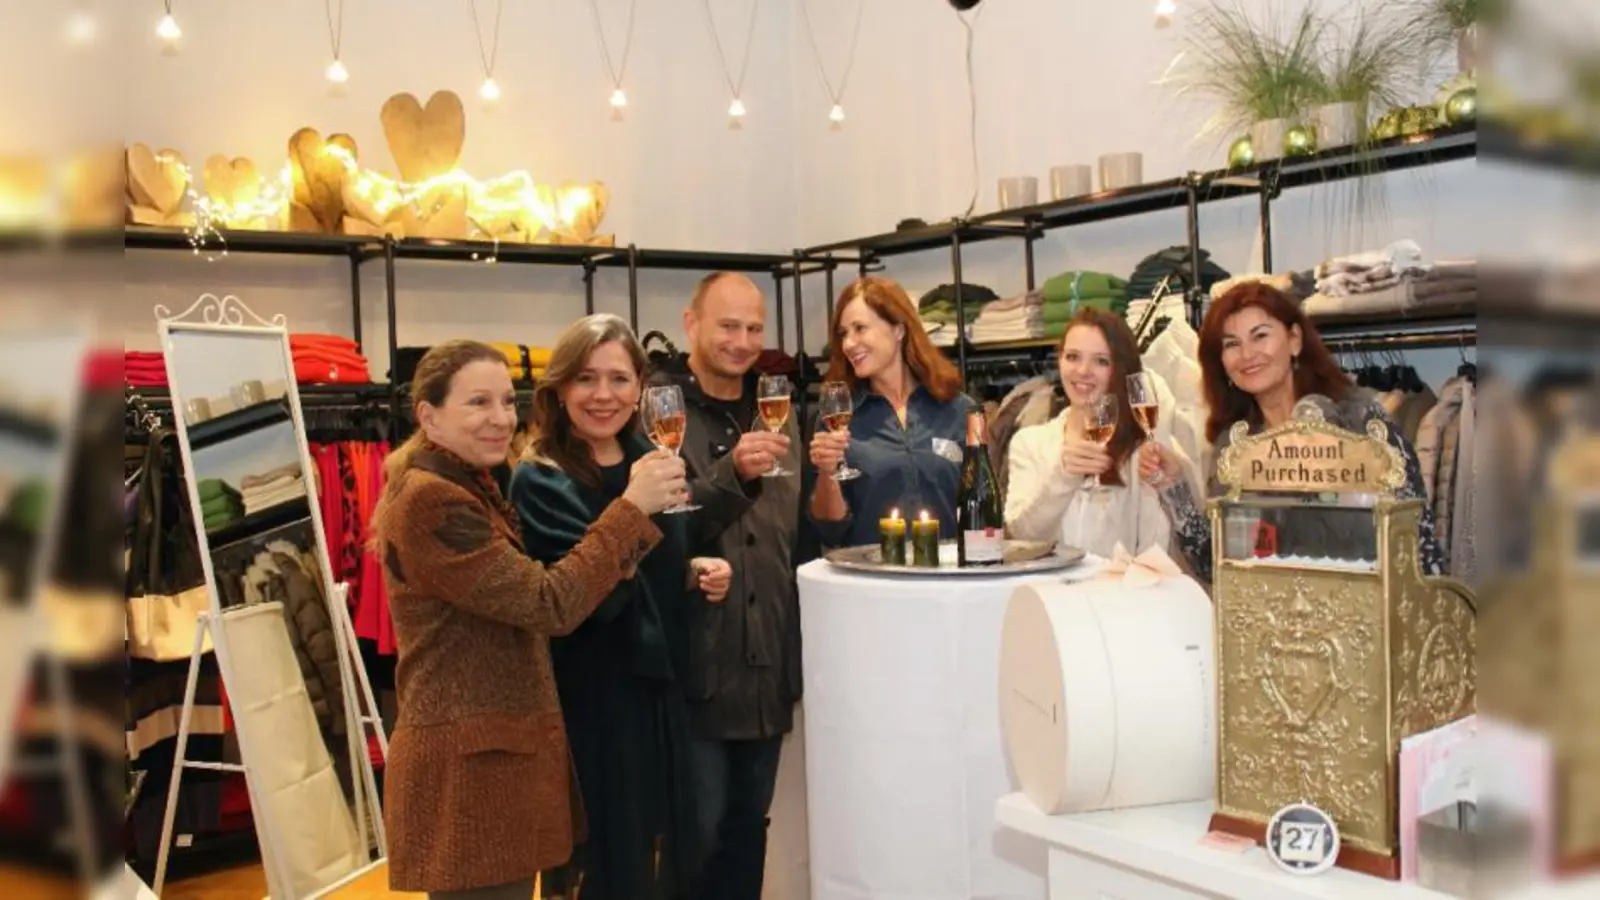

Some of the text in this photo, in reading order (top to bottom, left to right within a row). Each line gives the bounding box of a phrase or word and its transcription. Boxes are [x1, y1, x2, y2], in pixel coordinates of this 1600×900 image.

[1268, 439, 1345, 460] Amount
[1251, 461, 1367, 483] Purchased
[1285, 827, 1319, 851] 27
